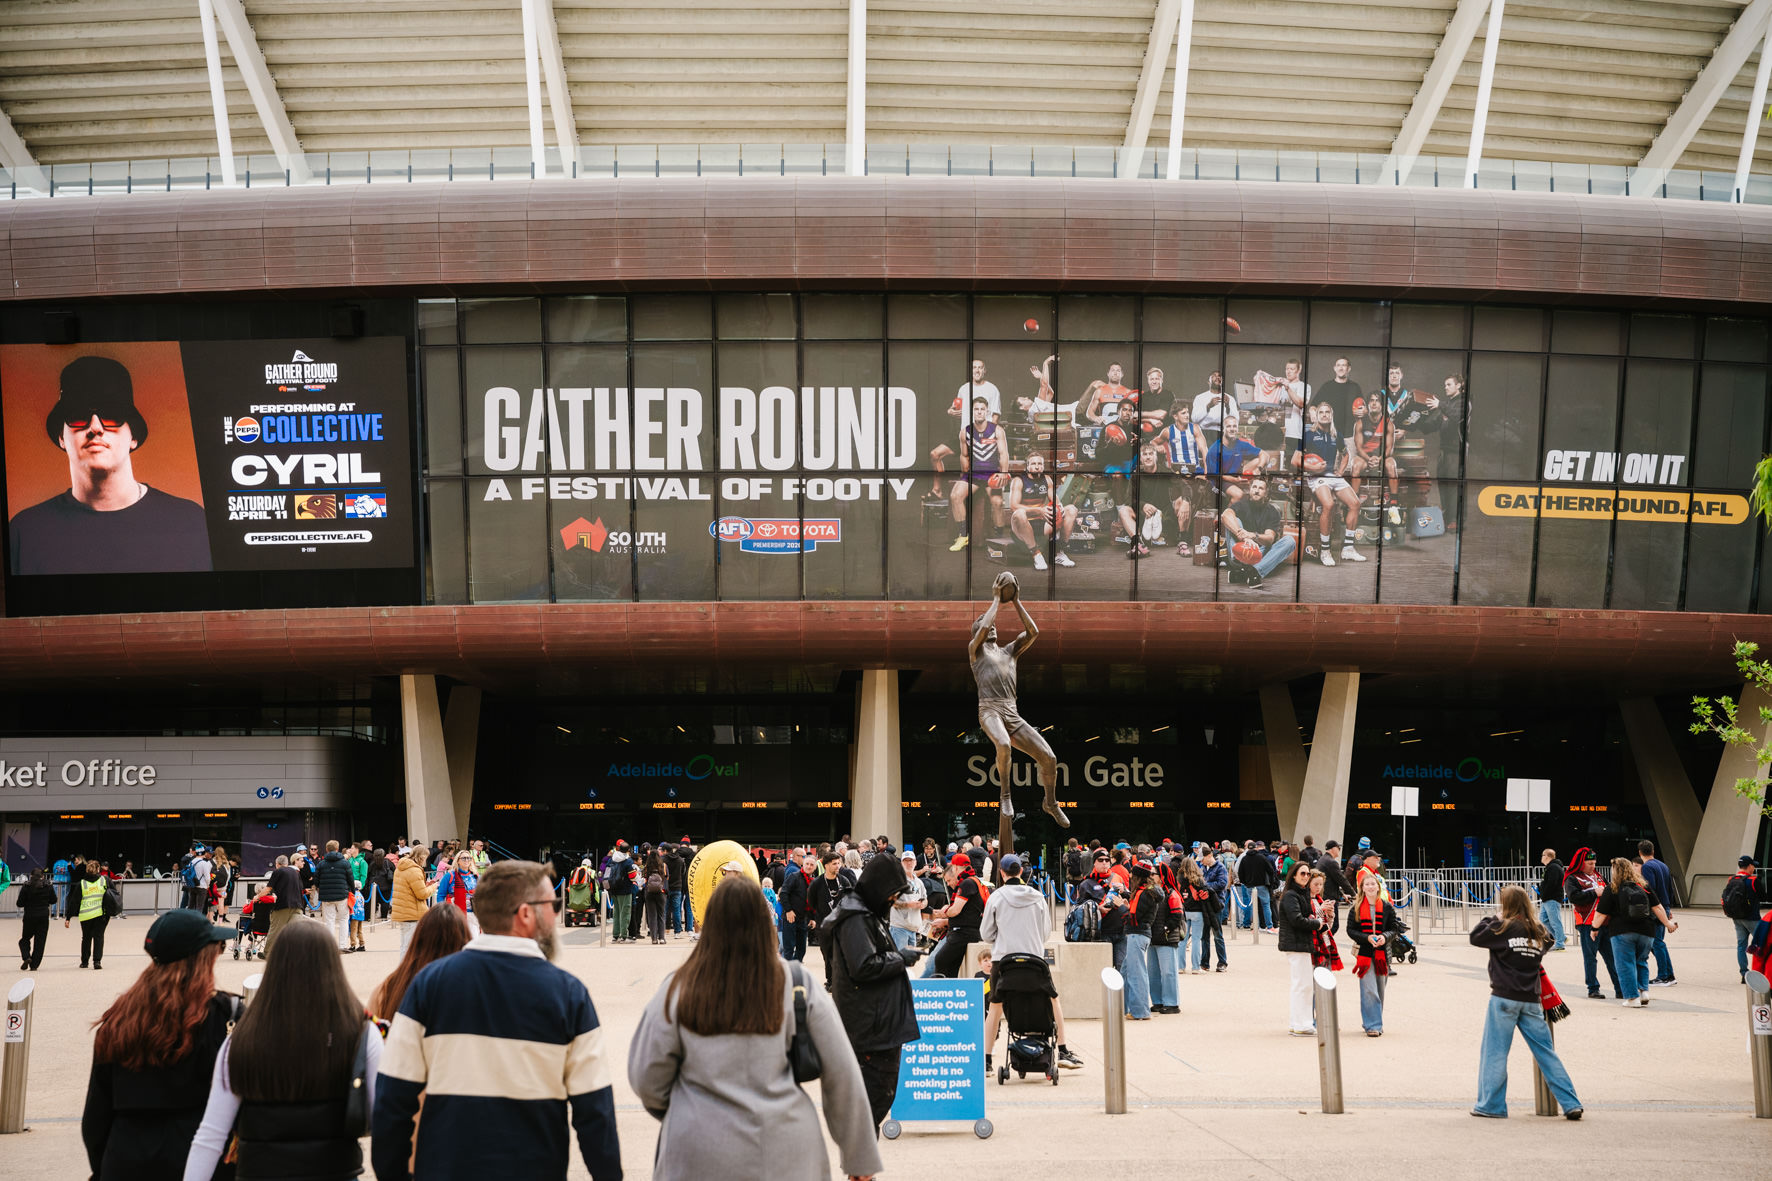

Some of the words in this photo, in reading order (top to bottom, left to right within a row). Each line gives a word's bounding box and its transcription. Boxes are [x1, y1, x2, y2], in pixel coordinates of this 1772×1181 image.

[265, 363, 302, 380] GATHER
[304, 363, 338, 379] ROUND
[250, 404, 336, 413] PERFORMING
[338, 403, 355, 412] AT
[224, 416, 232, 444] THE
[235, 426, 259, 434] PEPSI
[262, 413, 384, 444] COLLECTIVE
[484, 386, 703, 471] GATHER
[719, 386, 917, 470] ROUND
[231, 453, 381, 486] CYRIL
[1544, 450, 1591, 481] GET
[1592, 451, 1619, 482] IN
[1622, 453, 1659, 484] ON
[1659, 454, 1685, 485] IT
[484, 478, 512, 501] A
[521, 478, 711, 501] FESTIVAL
[721, 478, 773, 501] OF
[782, 478, 916, 501] FOOTY
[228, 496, 287, 512] SATURDAY
[1494, 493, 1734, 517] GATHERROUND.AFL
[229, 510, 271, 521] APRIL
[274, 510, 288, 520] 11
[713, 522, 751, 536] AFL
[781, 525, 836, 536] TOYOTA
[250, 532, 366, 543] PEPSICOLLECTIVE.AFL
[608, 531, 666, 546] SOUTH
[61, 759, 157, 787] Office
[607, 762, 683, 777] Adelaide
[684, 754, 739, 780] Oval
[1084, 754, 1165, 788] Gate
[1382, 764, 1453, 779] Adelaide
[1455, 756, 1505, 782] Oval
[912, 989, 954, 998] Welcome
[955, 989, 966, 998] to
[914, 1000, 944, 1009] elaide
[945, 1000, 968, 1010] Oval
[921, 1025, 954, 1033] venue.
[918, 1043, 934, 1052] the
[936, 1042, 976, 1052] comfort
[905, 1054, 917, 1064] of
[918, 1054, 930, 1064] all
[932, 1055, 970, 1066] patrons
[912, 1066, 939, 1076] there
[940, 1066, 948, 1076] is
[950, 1068, 963, 1076] no
[904, 1078, 947, 1089] smoking
[949, 1079, 971, 1089] past
[913, 1090, 932, 1100] this
[933, 1090, 963, 1101] point.
